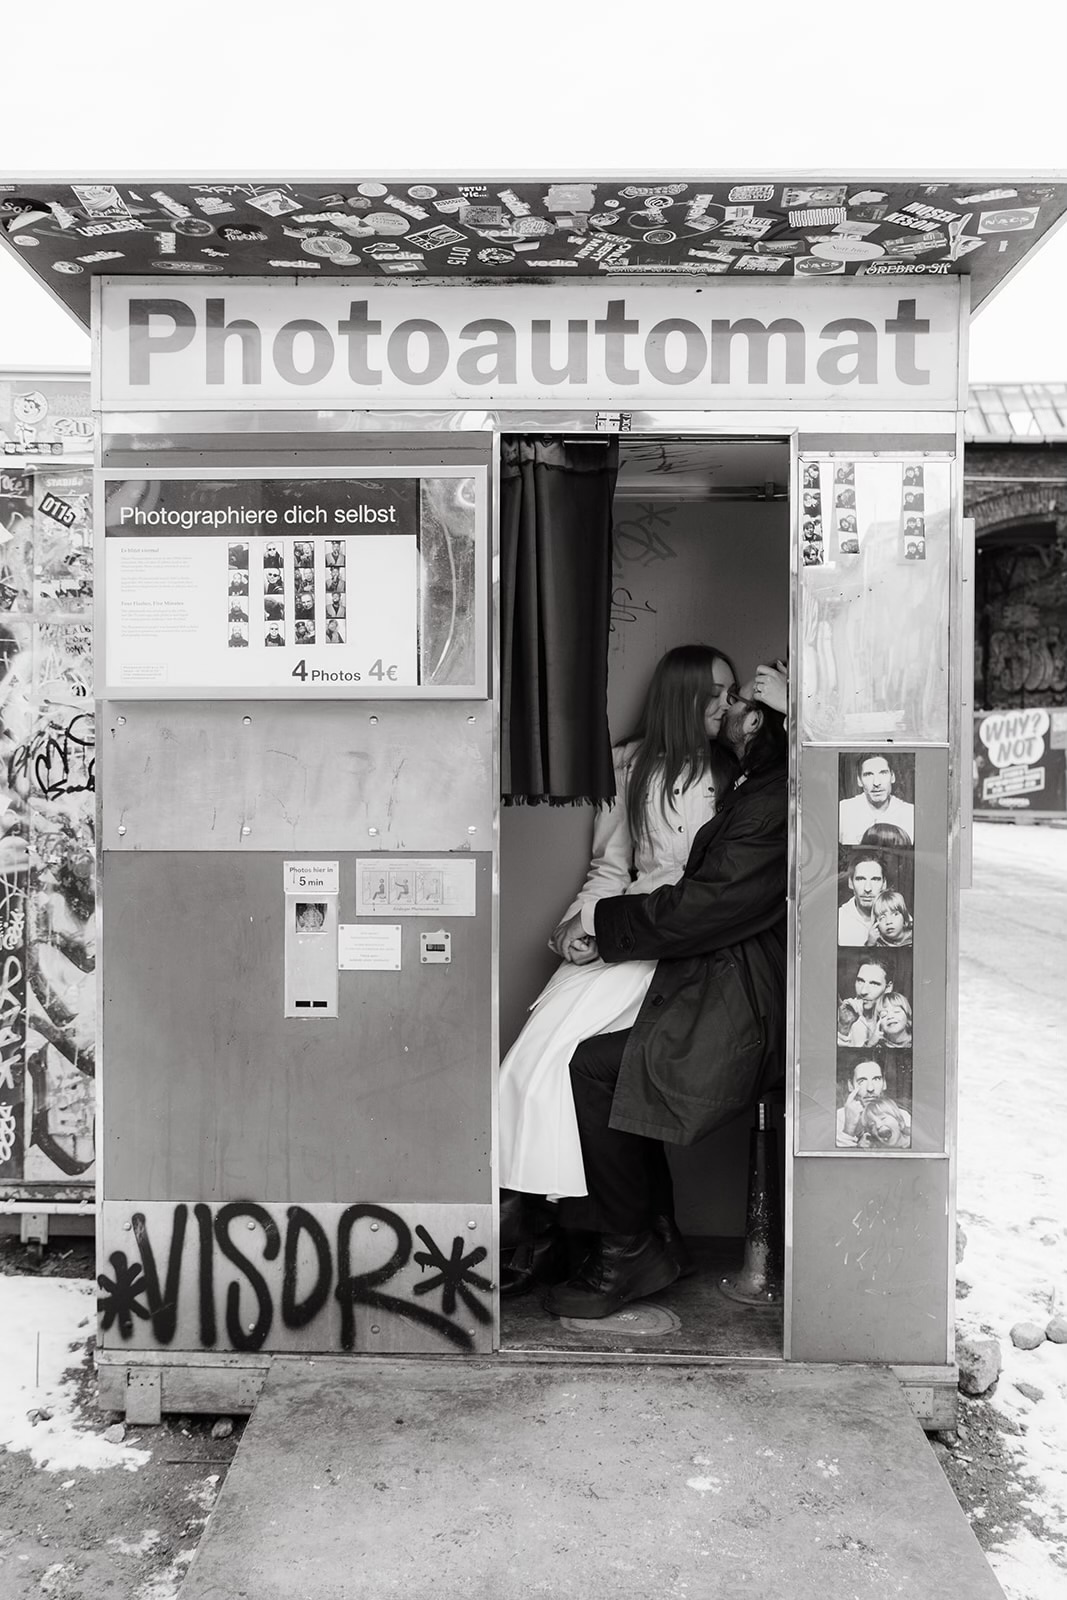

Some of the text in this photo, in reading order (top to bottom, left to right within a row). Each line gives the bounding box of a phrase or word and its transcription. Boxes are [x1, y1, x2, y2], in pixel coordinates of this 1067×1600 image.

[371, 251, 424, 261] vedia
[524, 258, 579, 267] vedia
[128, 298, 930, 387] Photoautomat
[41, 497, 76, 524] 0115
[120, 505, 396, 529] Photographiere dich selbst
[292, 659, 398, 682] 4 Photos 4€
[985, 712, 1042, 742] WHY?
[997, 736, 1037, 762] NOT
[299, 876, 324, 886] 5 min
